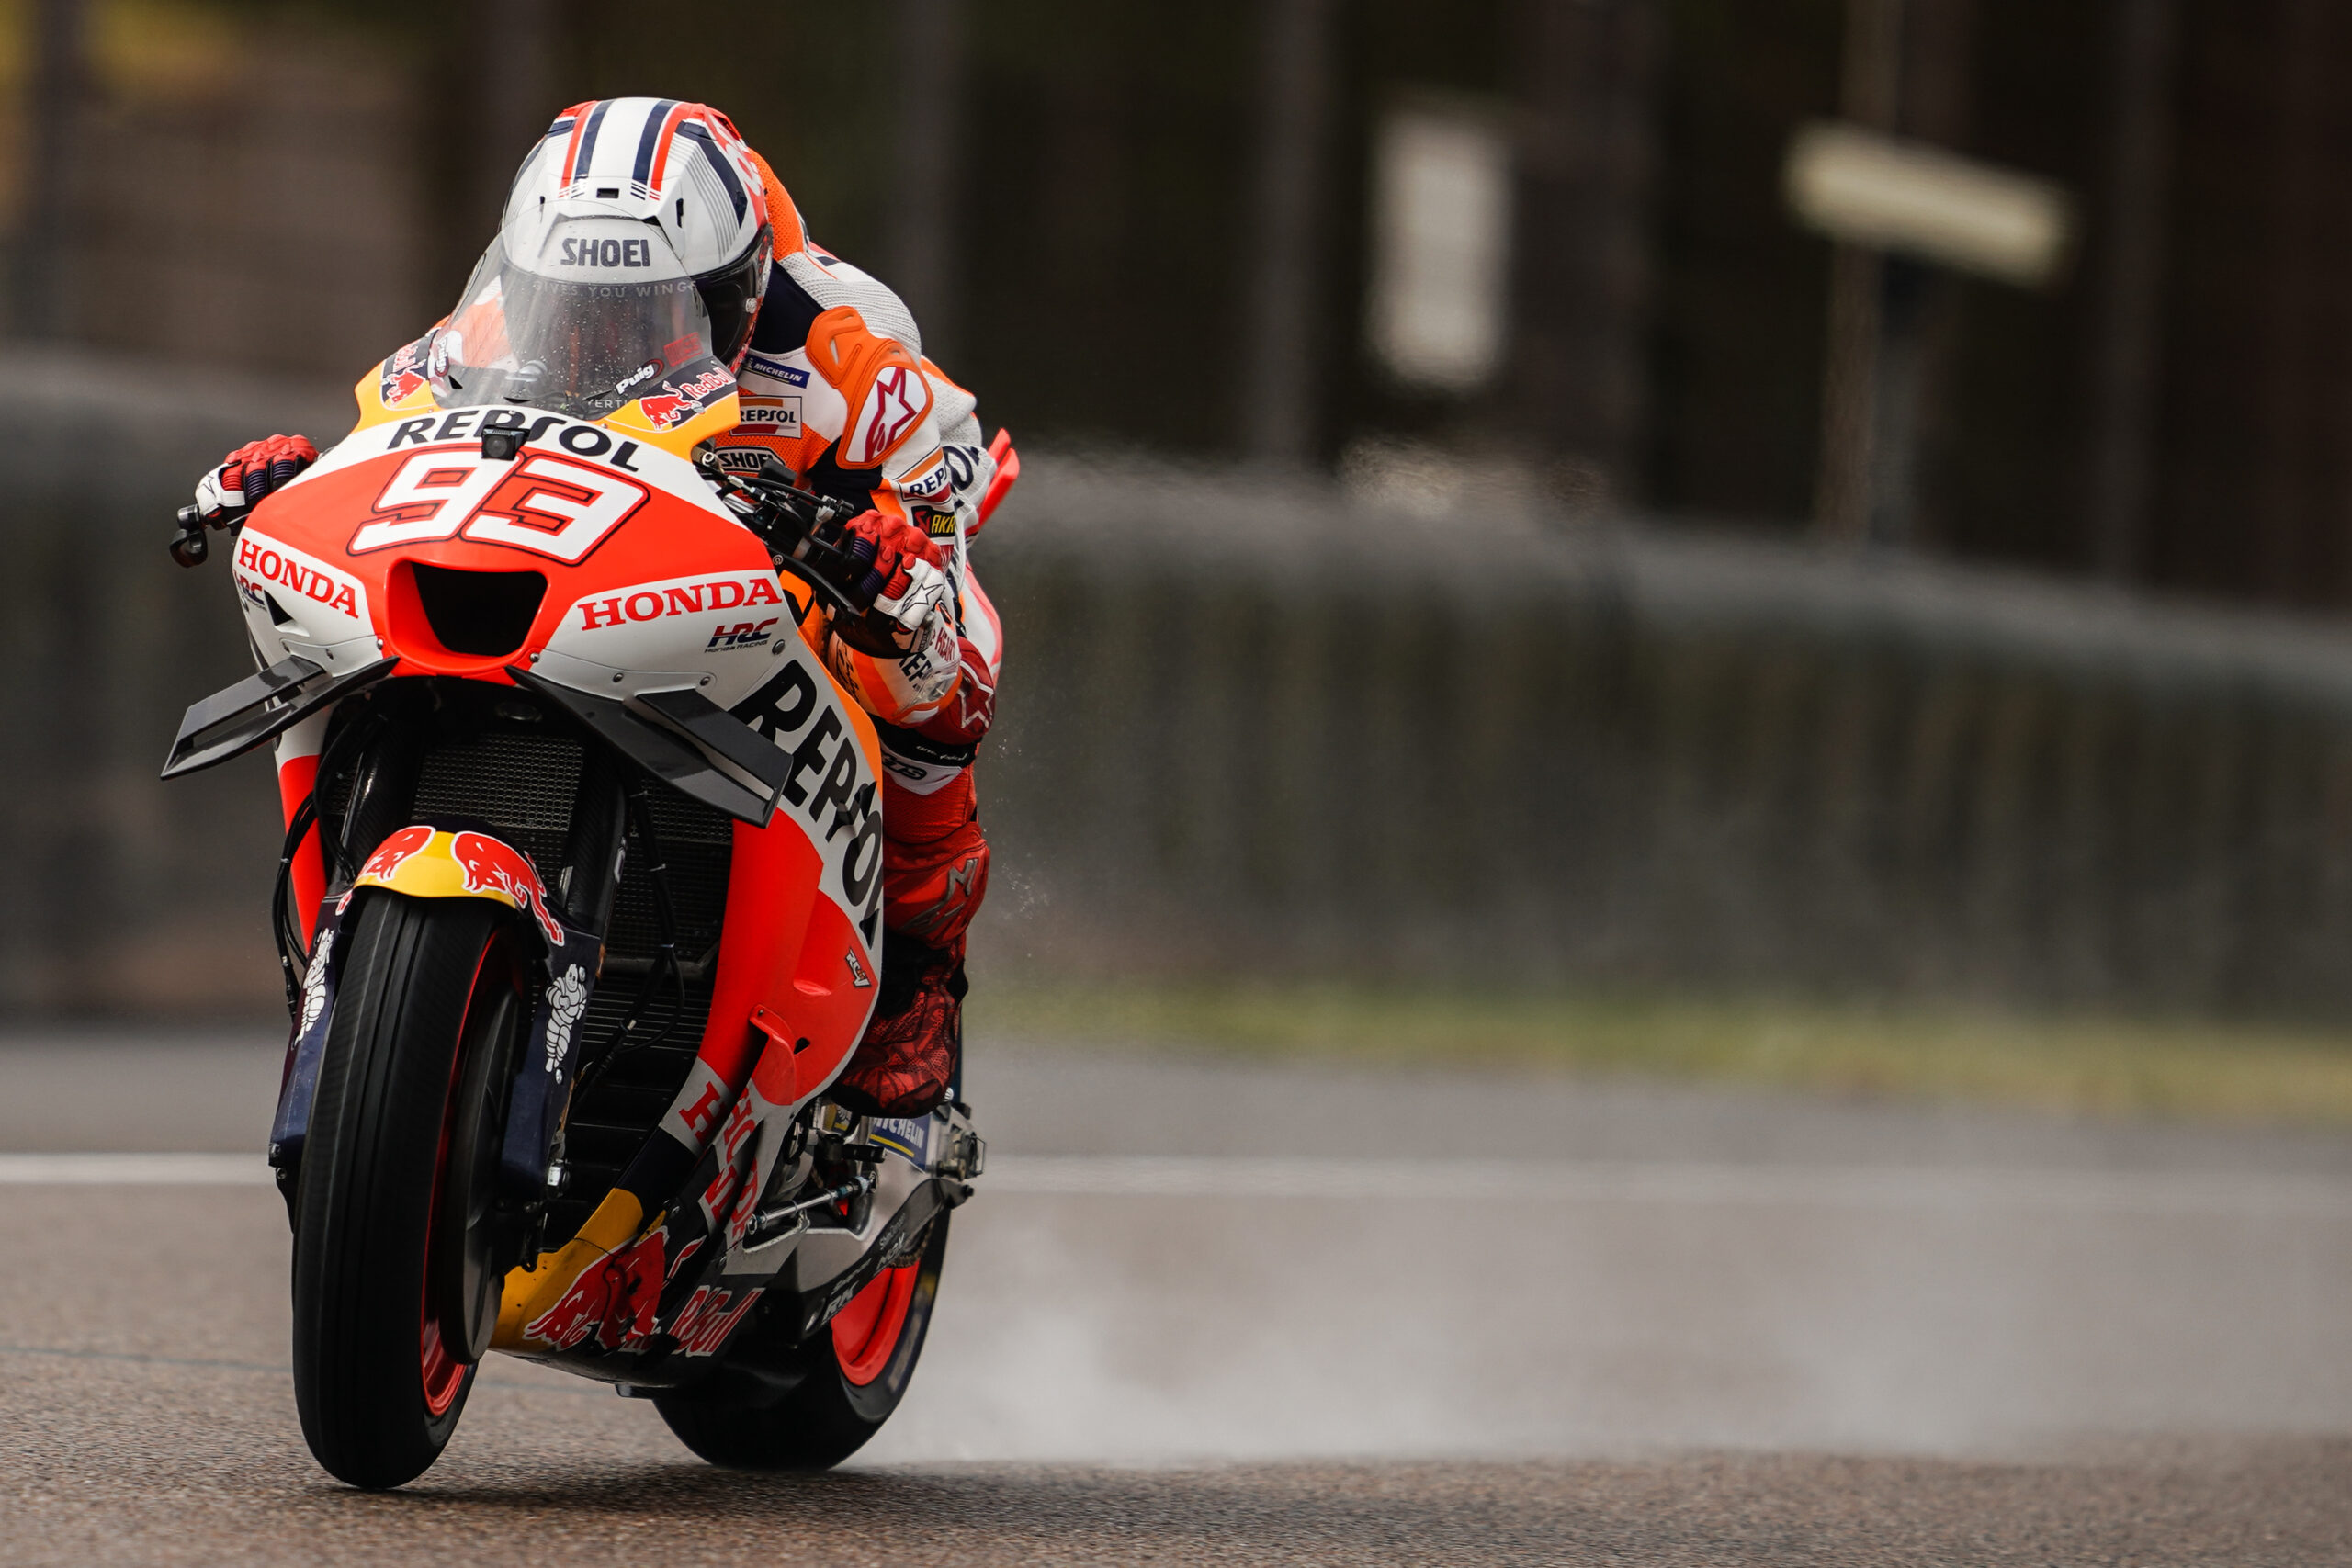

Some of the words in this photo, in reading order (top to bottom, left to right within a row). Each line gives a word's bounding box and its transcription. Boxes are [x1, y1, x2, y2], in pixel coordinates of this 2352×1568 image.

[560, 237, 651, 267] SHOEI
[588, 286, 626, 298] YOU
[616, 364, 655, 396] Puig
[754, 362, 803, 382] MICHELIN
[387, 409, 639, 472] REPSOL
[346, 446, 650, 567] 93
[239, 538, 359, 619] HONDA
[577, 578, 782, 631] HONDA
[707, 617, 779, 648] HRC
